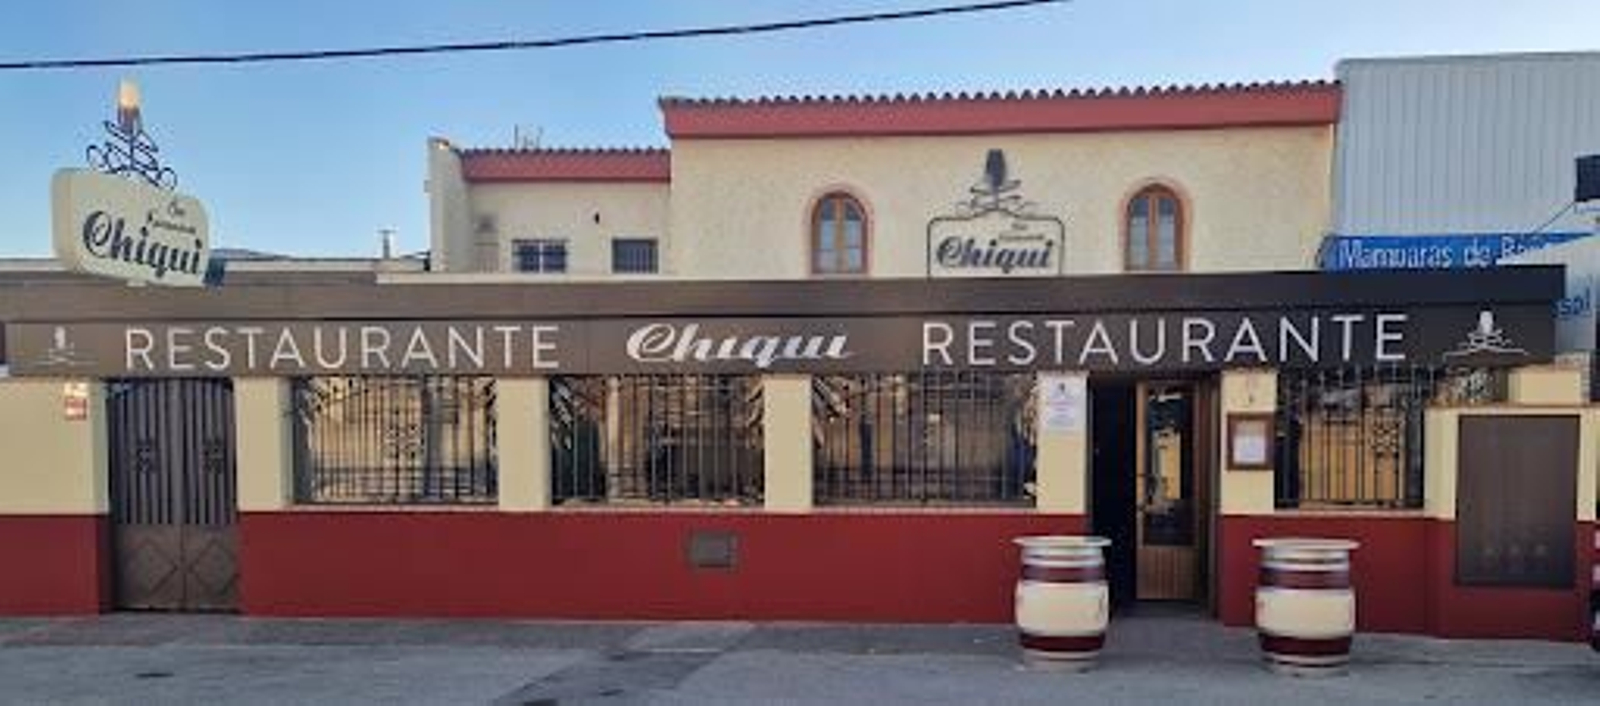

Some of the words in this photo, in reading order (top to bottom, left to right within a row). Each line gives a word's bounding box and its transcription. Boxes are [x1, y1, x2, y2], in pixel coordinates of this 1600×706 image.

[83, 210, 203, 278] Chiqui
[936, 236, 1053, 274] Chiqui
[1464, 237, 1490, 268] de
[124, 325, 559, 370] RESTAURANTE
[626, 323, 850, 368] Chiqui
[922, 313, 1407, 366] RESTAURANTE
